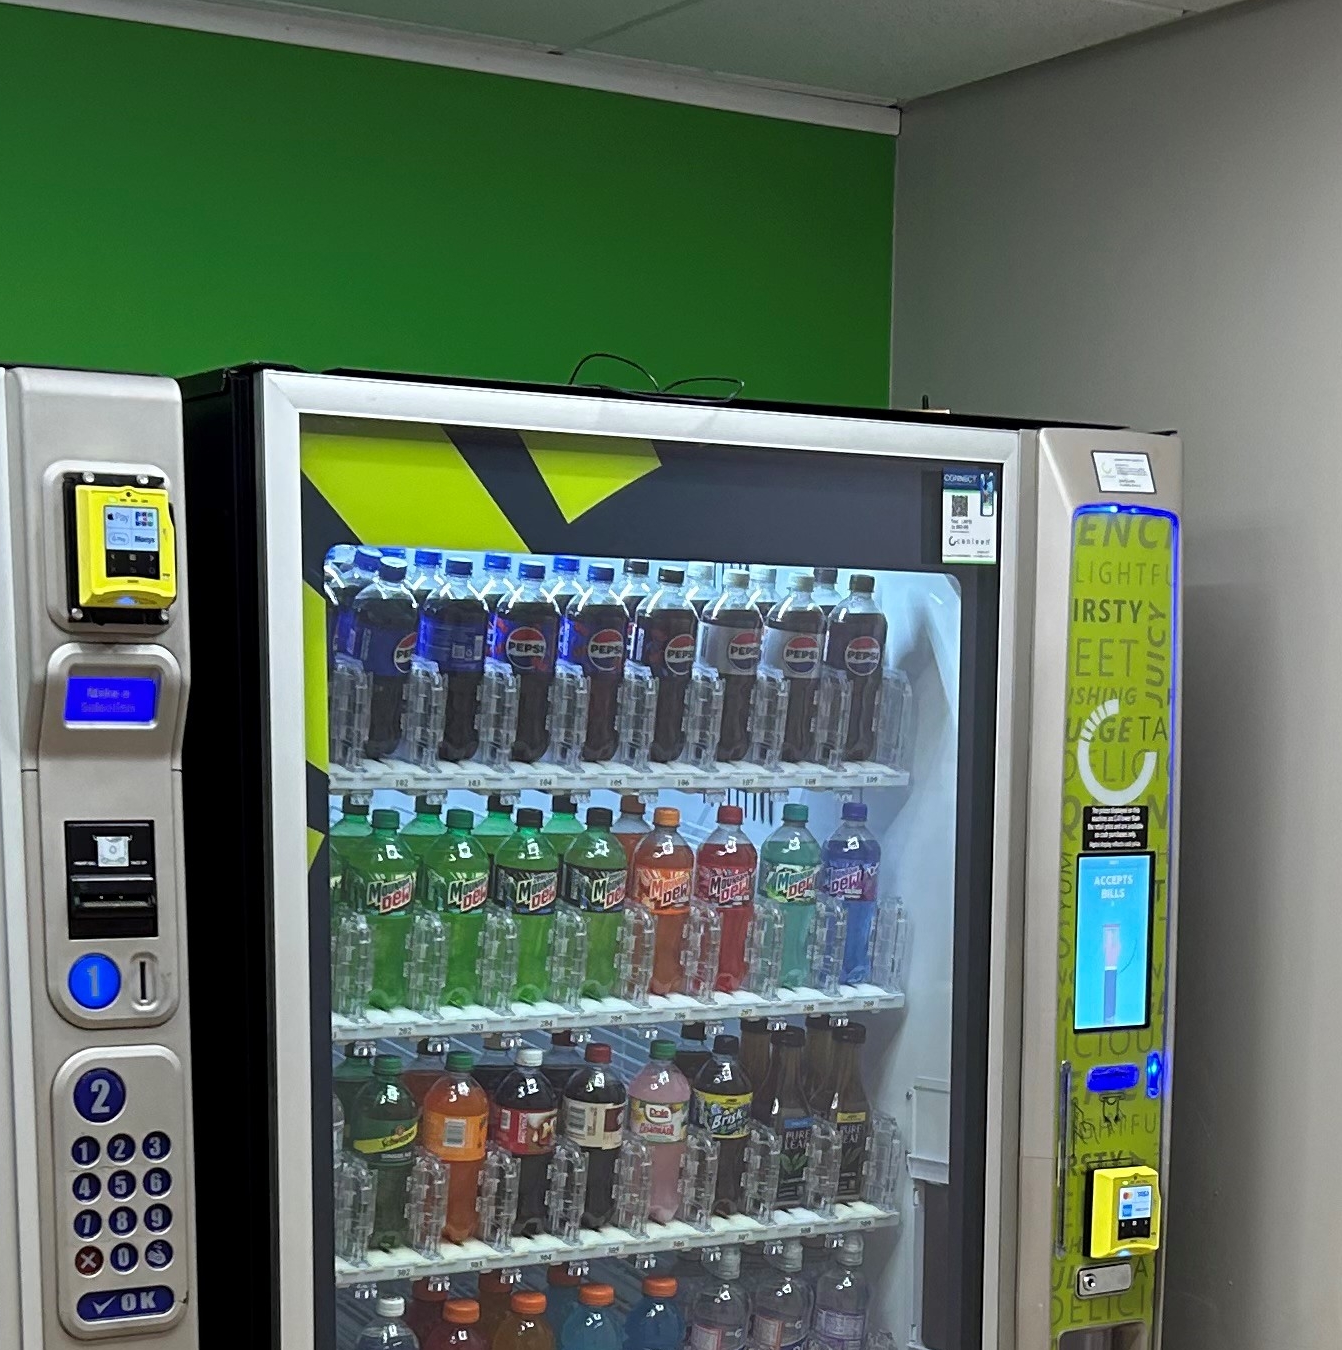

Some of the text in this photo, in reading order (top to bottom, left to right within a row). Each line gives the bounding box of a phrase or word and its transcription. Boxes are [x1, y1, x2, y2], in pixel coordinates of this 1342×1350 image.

[1073, 598, 1143, 624] IRSTY
[507, 641, 545, 656] PEPSI
[730, 644, 761, 658] PEPS
[847, 650, 880, 662] PEPSI
[1075, 637, 1140, 678] EET
[1145, 601, 1167, 709] JUICY
[1093, 874, 1134, 887] ACCEPTS
[1100, 888, 1125, 900] BILLS
[86, 965, 99, 998] 1
[89, 1078, 111, 1115] 2
[649, 1107, 669, 1119] Dole
[711, 1111, 744, 1130] Brisk
[149, 1136, 162, 1156] 3
[785, 1130, 811, 1142] PURE
[78, 1141, 89, 1162] 1
[114, 1138, 126, 1159] 2
[78, 1177, 92, 1198] 4
[114, 1175, 128, 1195] 5
[149, 1172, 163, 1192] 6
[81, 1214, 92, 1234] 7
[116, 1211, 129, 1231] 8
[150, 1208, 164, 1228] 9
[117, 1247, 131, 1268] 0
[120, 1290, 158, 1313] OK
